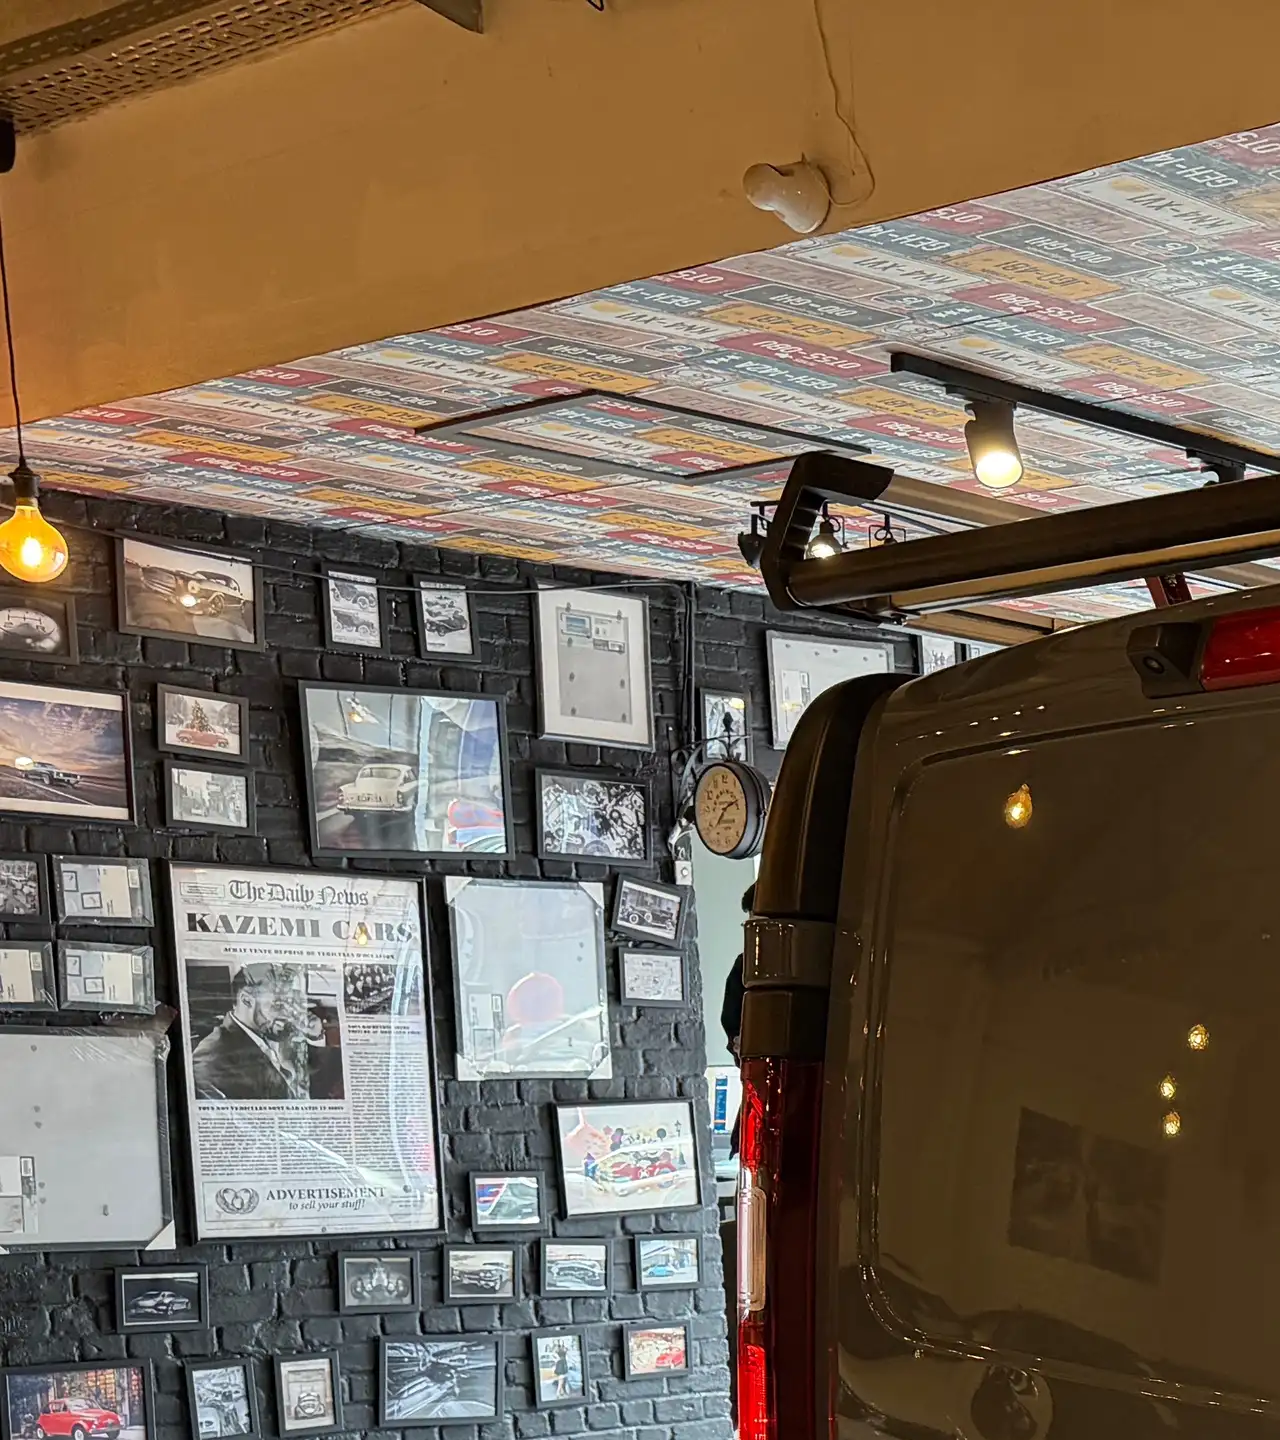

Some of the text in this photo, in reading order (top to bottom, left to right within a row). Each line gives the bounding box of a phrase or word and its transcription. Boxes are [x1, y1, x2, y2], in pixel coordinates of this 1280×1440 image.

[228, 879, 267, 903] The
[266, 881, 314, 905] Daily
[316, 885, 369, 907] News
[187, 912, 413, 943] KAZEMI CARS
[266, 1185, 387, 1201] ADVERTISEMENT
[289, 1200, 299, 1210] to
[300, 1199, 316, 1210] sell
[316, 1201, 339, 1213] your
